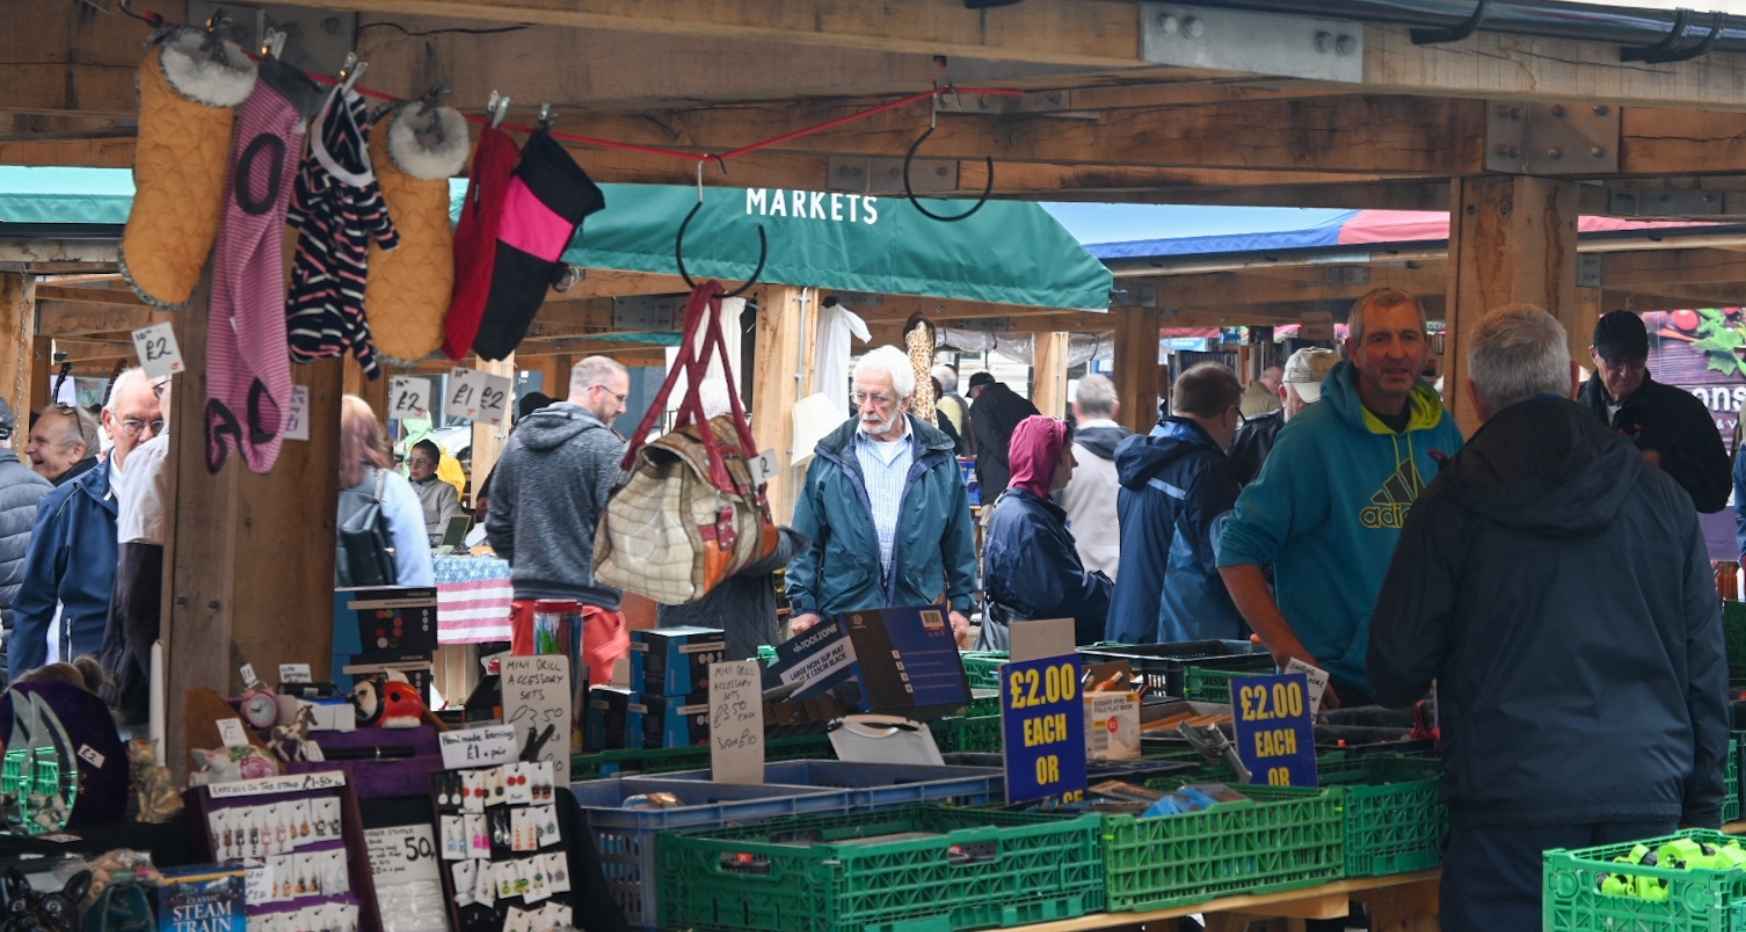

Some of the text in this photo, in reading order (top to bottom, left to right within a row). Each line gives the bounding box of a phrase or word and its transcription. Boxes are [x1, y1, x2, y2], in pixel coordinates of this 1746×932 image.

[746, 187, 878, 225] MARKETS
[145, 336, 172, 362] £2
[396, 391, 420, 411] £2
[452, 383, 474, 406] £1
[480, 386, 505, 410] £2
[507, 660, 529, 670] MINI
[1010, 663, 1076, 709] £2.00
[1240, 681, 1303, 721] £2.00
[1023, 713, 1067, 747] EACH
[1254, 728, 1297, 758] EACH
[1036, 754, 1059, 785] OR
[1268, 767, 1290, 787] OR
[173, 900, 232, 921] STEAM
[175, 917, 233, 932] TRAIN
